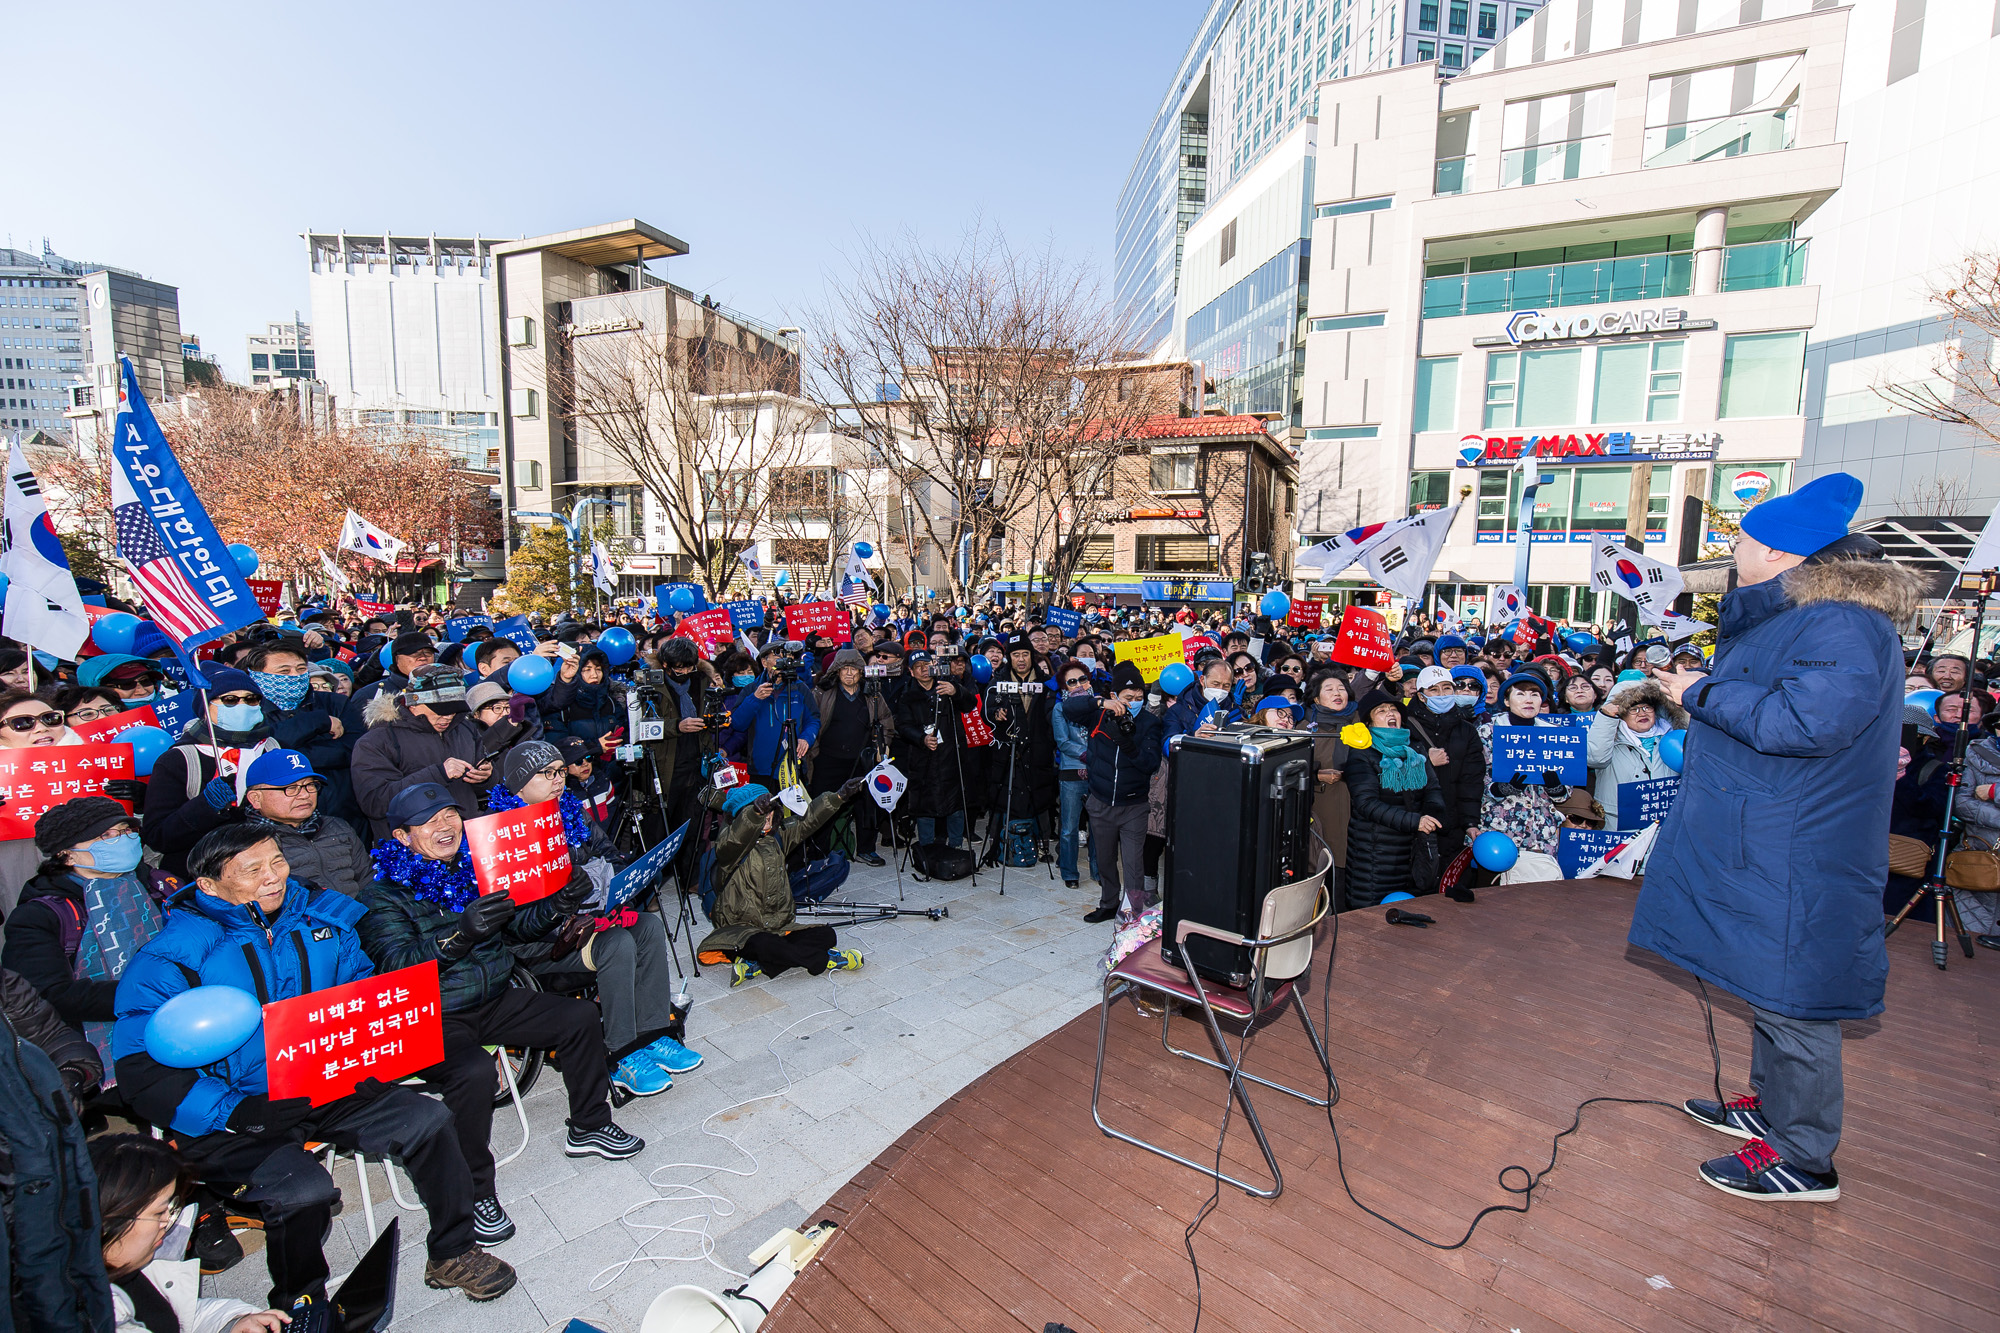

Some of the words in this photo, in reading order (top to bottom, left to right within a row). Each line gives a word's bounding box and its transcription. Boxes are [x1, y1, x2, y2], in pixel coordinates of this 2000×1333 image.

[1514, 306, 1680, 340] CRYOCARE
[125, 423, 238, 608] 자유대한연대
[1164, 586, 1208, 596] CUPASTEAK
[1354, 616, 1369, 628] 국민
[1376, 622, 1387, 633] 언론
[1346, 630, 1370, 641] 속이고
[1134, 643, 1164, 653] 한국당은
[1153, 650, 1181, 662] 방남투쟁
[1793, 659, 1837, 667] Marmot
[1500, 734, 1531, 744] 이땅이
[1538, 734, 1581, 744] 어디라고
[1505, 749, 1536, 759] 김정은
[1542, 749, 1575, 760] 맘대로
[30, 759, 67, 775] 죽인
[77, 755, 126, 771] 수백만
[286, 754, 306, 769] L
[1514, 764, 1565, 775] 오고가냐?
[1641, 790, 1678, 801] 책임지고
[1641, 801, 1672, 812] 문재인
[487, 822, 527, 843] 6백만
[1569, 832, 1595, 842] 문재인
[480, 842, 541, 870] 망하는데
[309, 998, 366, 1023] 비핵화
[376, 987, 410, 1009] 없는
[276, 1027, 357, 1061] 사기방남
[368, 1002, 435, 1037] 전국민이
[322, 1039, 403, 1080] 분노한다!
